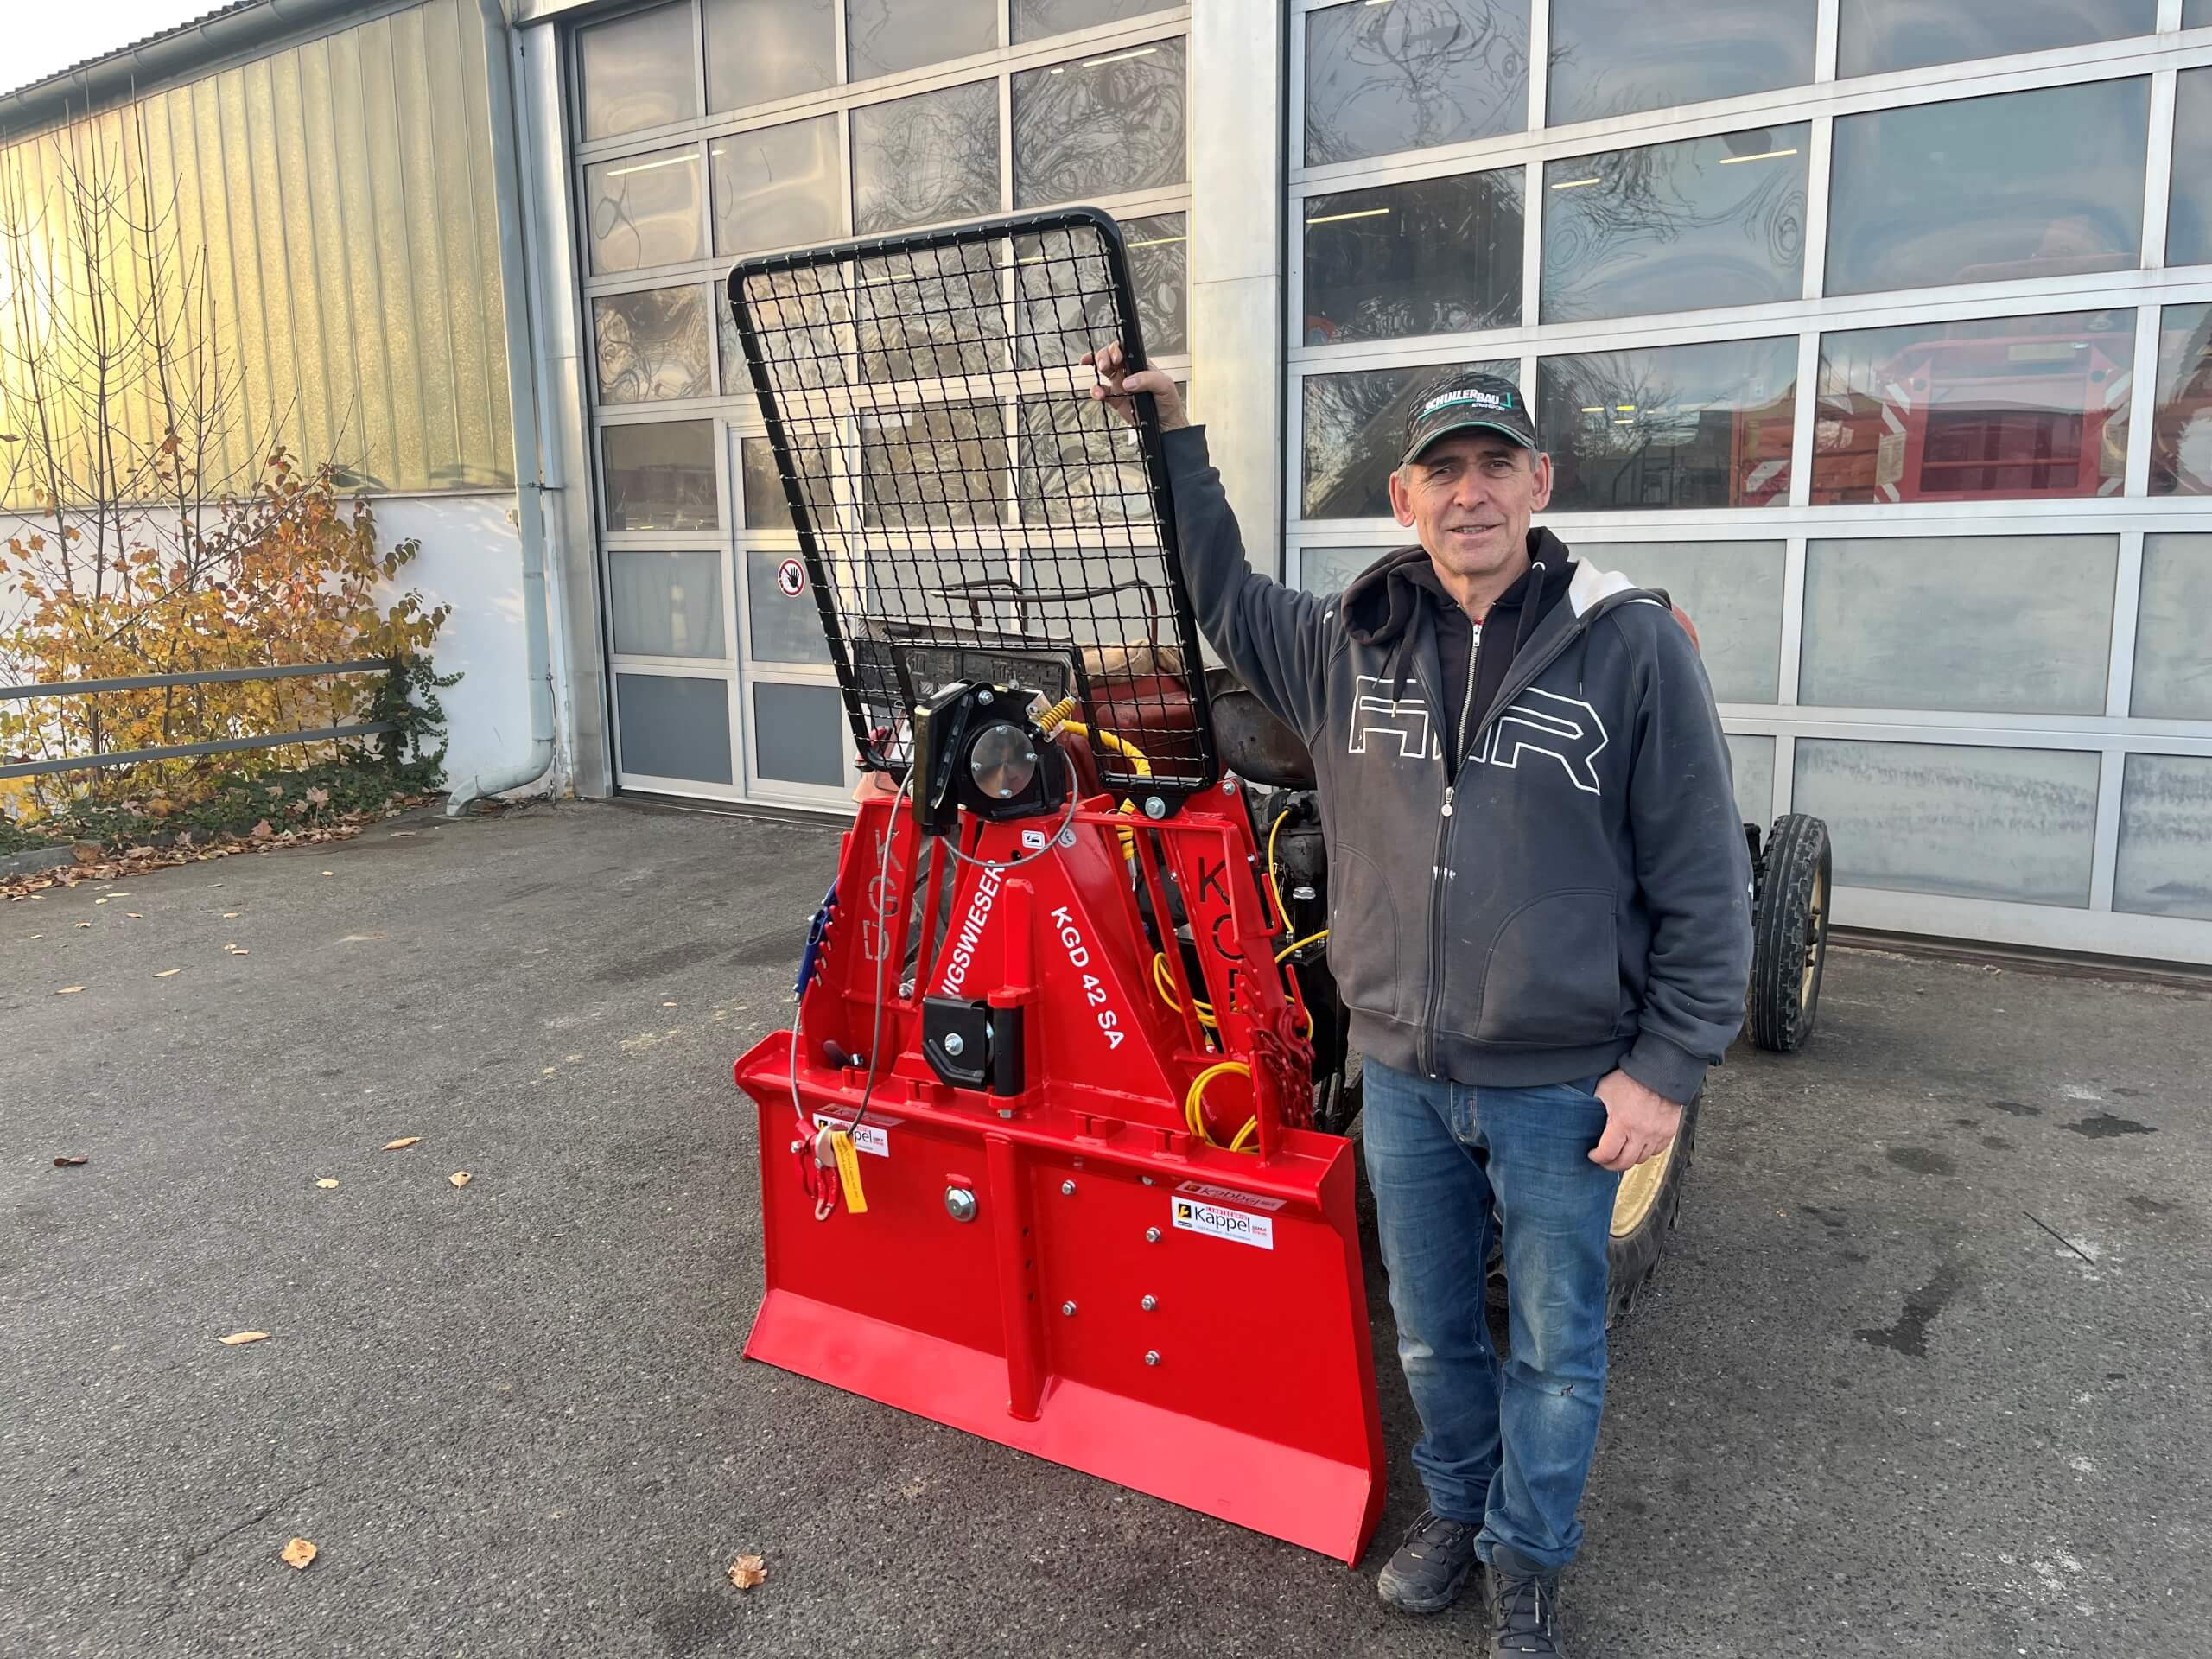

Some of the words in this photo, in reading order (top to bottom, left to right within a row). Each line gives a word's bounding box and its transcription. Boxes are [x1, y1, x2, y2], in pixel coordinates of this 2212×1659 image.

[1051, 906, 1090, 969] KGD
[1083, 974, 1107, 1007] 42
[1097, 1011, 1125, 1050] SA
[1194, 1206, 1250, 1233] Kappel
